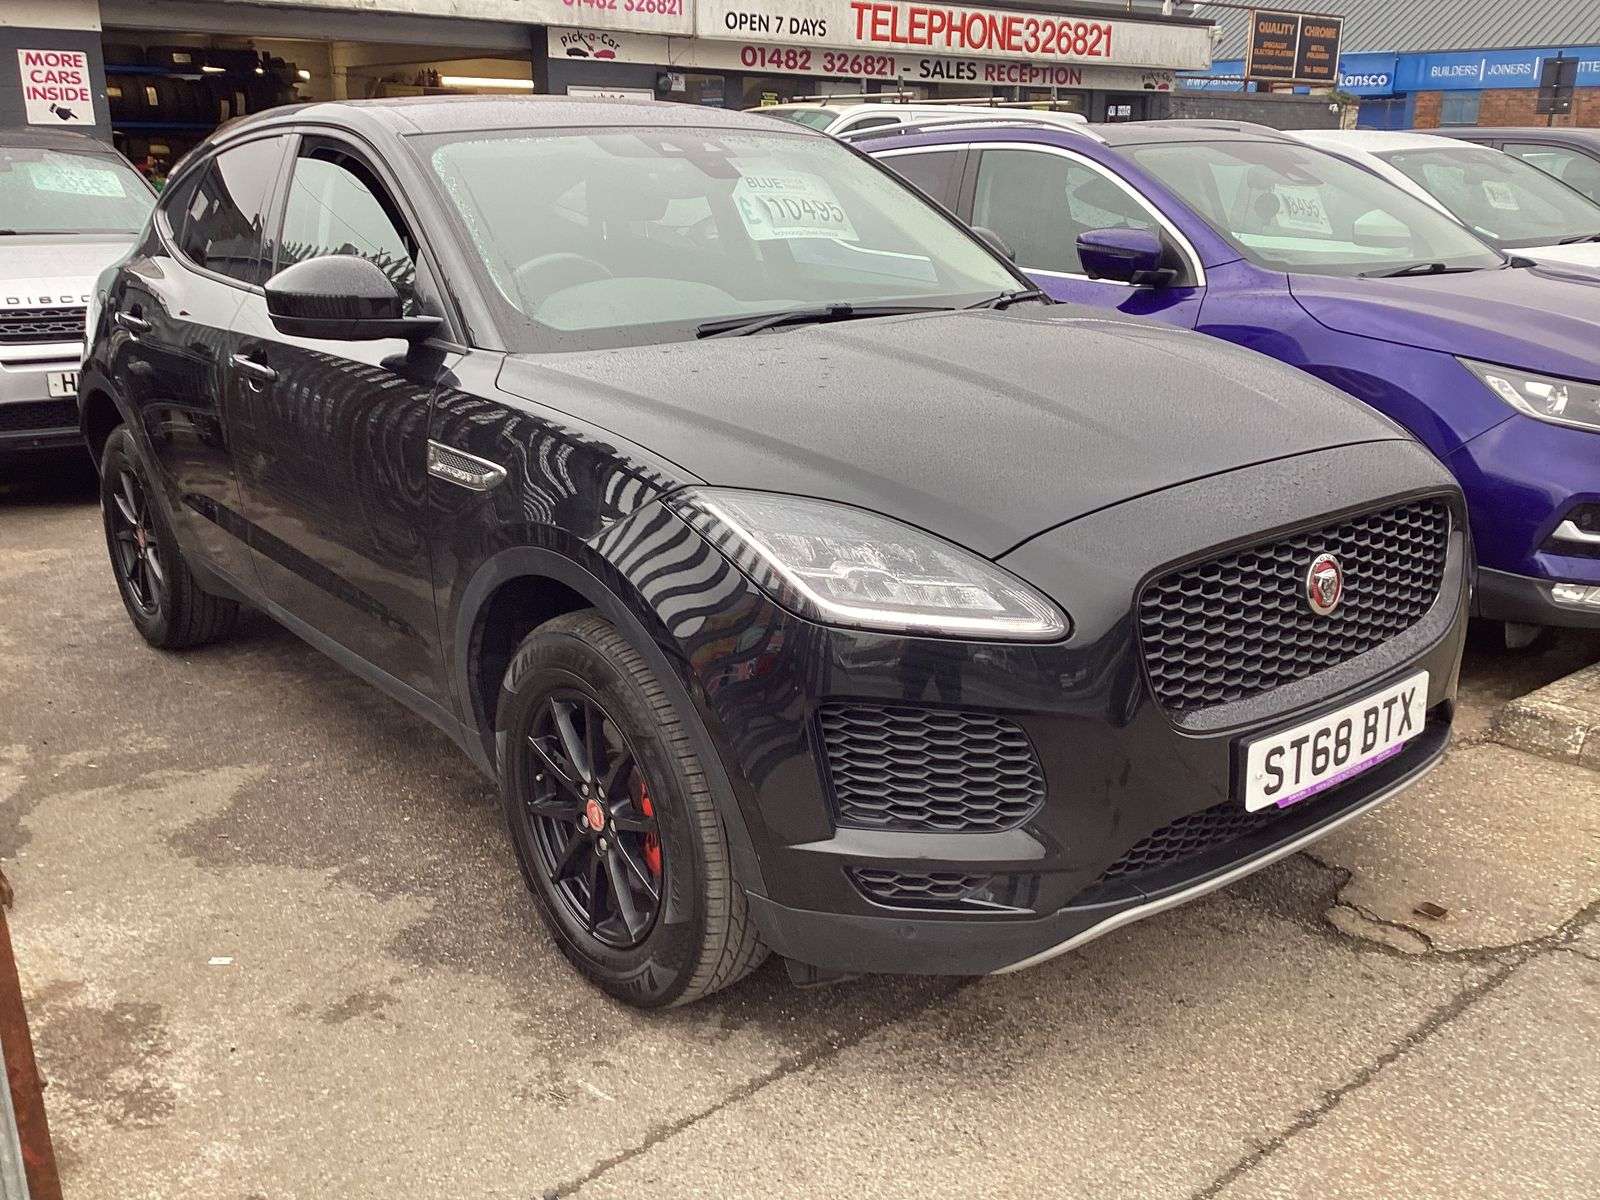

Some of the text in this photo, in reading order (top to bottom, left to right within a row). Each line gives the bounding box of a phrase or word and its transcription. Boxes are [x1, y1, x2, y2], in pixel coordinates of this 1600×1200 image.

[725, 11, 827, 37] OPEN 7 DAYS
[1258, 21, 1295, 35] QUALITY
[1304, 25, 1336, 38] CHROME
[25, 52, 84, 68] MORE
[740, 45, 812, 71] 01482
[823, 51, 896, 76] 326821
[919, 58, 977, 80] SALES
[984, 61, 1082, 85] RECEPTION
[1431, 64, 1478, 77] BUILDERS
[1488, 62, 1531, 75] JOINERS
[30, 70, 82, 85] CARS
[1338, 72, 1389, 87] Lansco
[26, 86, 90, 101] INSIDE
[61, 373, 80, 393] H
[1263, 718, 1353, 796] ST68
[1361, 687, 1416, 755] BTX
